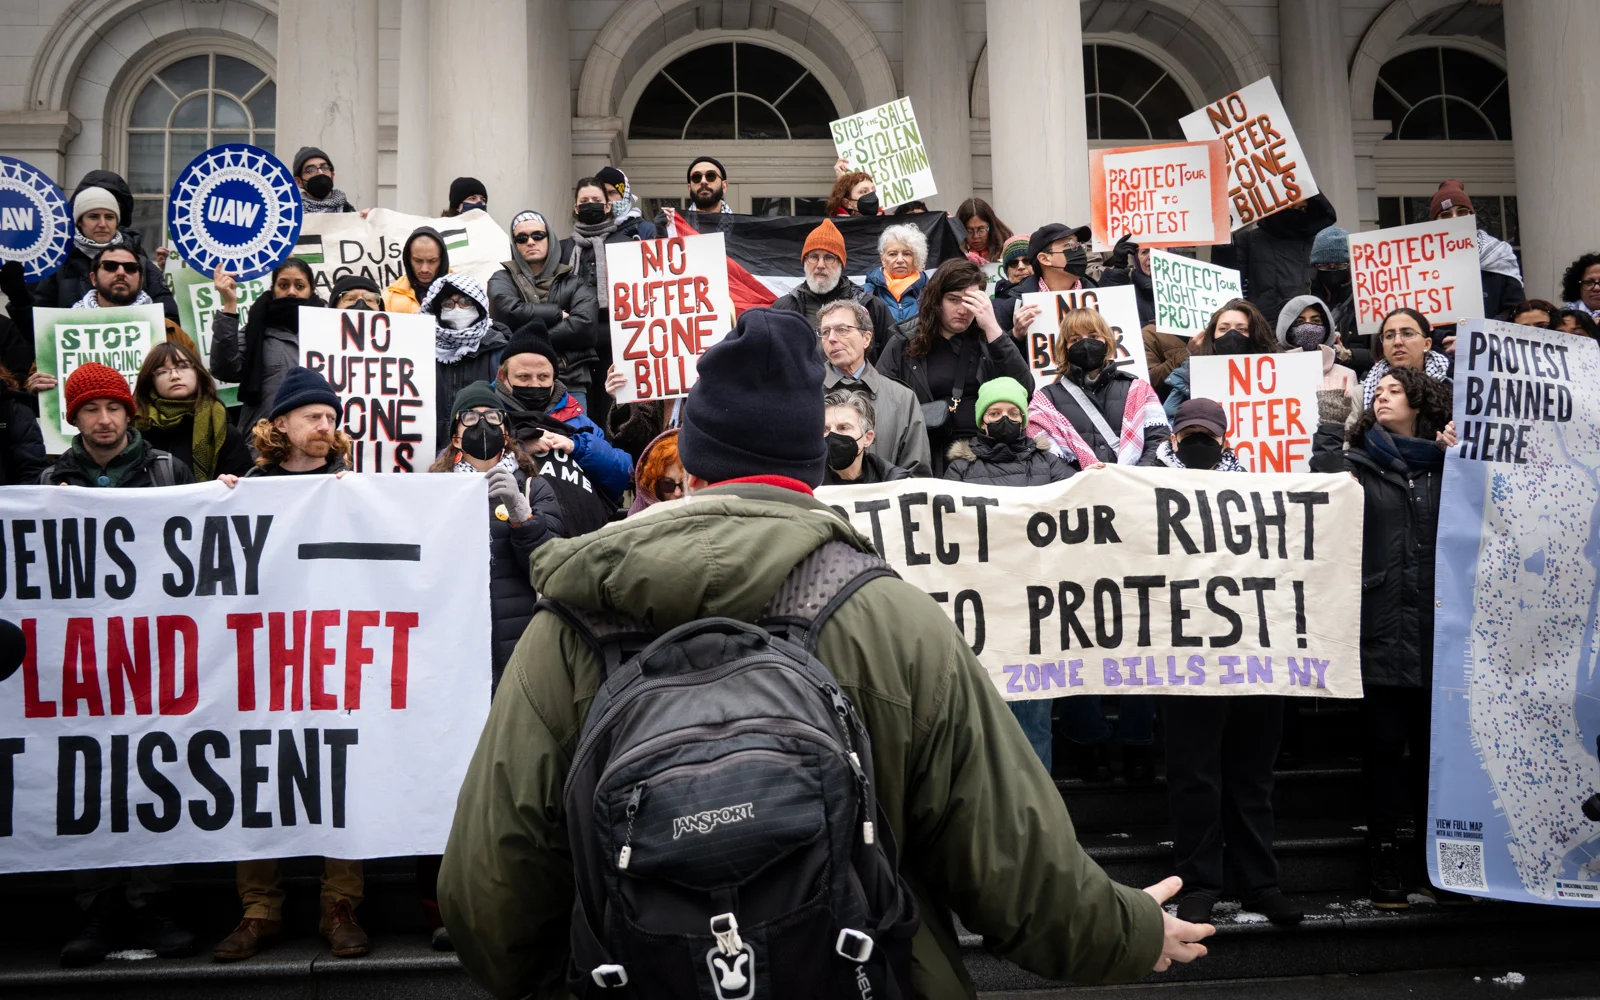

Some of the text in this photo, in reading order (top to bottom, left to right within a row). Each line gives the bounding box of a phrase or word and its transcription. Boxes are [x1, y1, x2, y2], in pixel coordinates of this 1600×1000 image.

[833, 117, 864, 144] STOP
[877, 98, 914, 130] SALE
[1206, 92, 1247, 134] NO
[842, 121, 920, 164] OF STOLEN
[881, 178, 914, 208] AND
[1109, 163, 1207, 192] PROTECT OUR
[1233, 171, 1302, 224] BILLS
[0, 207, 34, 231] AW
[207, 196, 261, 228] UAW
[1110, 189, 1179, 214] RIGHT TO
[1111, 210, 1189, 239] PROTEST
[340, 235, 402, 265] DJs
[641, 236, 686, 278] NO
[1352, 231, 1475, 271] PROTECT OUR
[315, 261, 403, 292] AGAIN
[1153, 255, 1221, 292] PROTECT
[1219, 279, 1239, 292] OUR
[1156, 280, 1218, 307] RIGHT TO
[1355, 265, 1440, 298] RIGHT TO
[613, 275, 714, 321] BUFFER
[1158, 304, 1211, 330] PROTE
[1358, 286, 1455, 324] PROTEST
[61, 325, 141, 350] STOP
[341, 312, 391, 351] NO
[621, 315, 718, 360] ZONE
[1228, 355, 1276, 396] NO
[1468, 331, 1571, 381] PROTEST
[634, 355, 697, 399] BILL
[1220, 398, 1306, 438] UFFER
[1465, 376, 1573, 422] BANNED
[341, 396, 423, 443] ONE
[1233, 439, 1311, 473] ONE
[1459, 420, 1531, 464] HERE
[539, 461, 593, 493] AME
[842, 487, 1329, 566] TECT OUR RIGHT
[162, 514, 274, 597] SAY
[1027, 575, 1307, 655] PROTEST!
[22, 610, 419, 719] LAND THEFT
[1002, 654, 1330, 695] ZONE BILLS IN NY
[57, 728, 358, 837] DISSENT
[673, 803, 753, 840] JANSPORT
[1436, 818, 1483, 831] VIEW FULL MAP
[855, 964, 873, 1000] HEL
